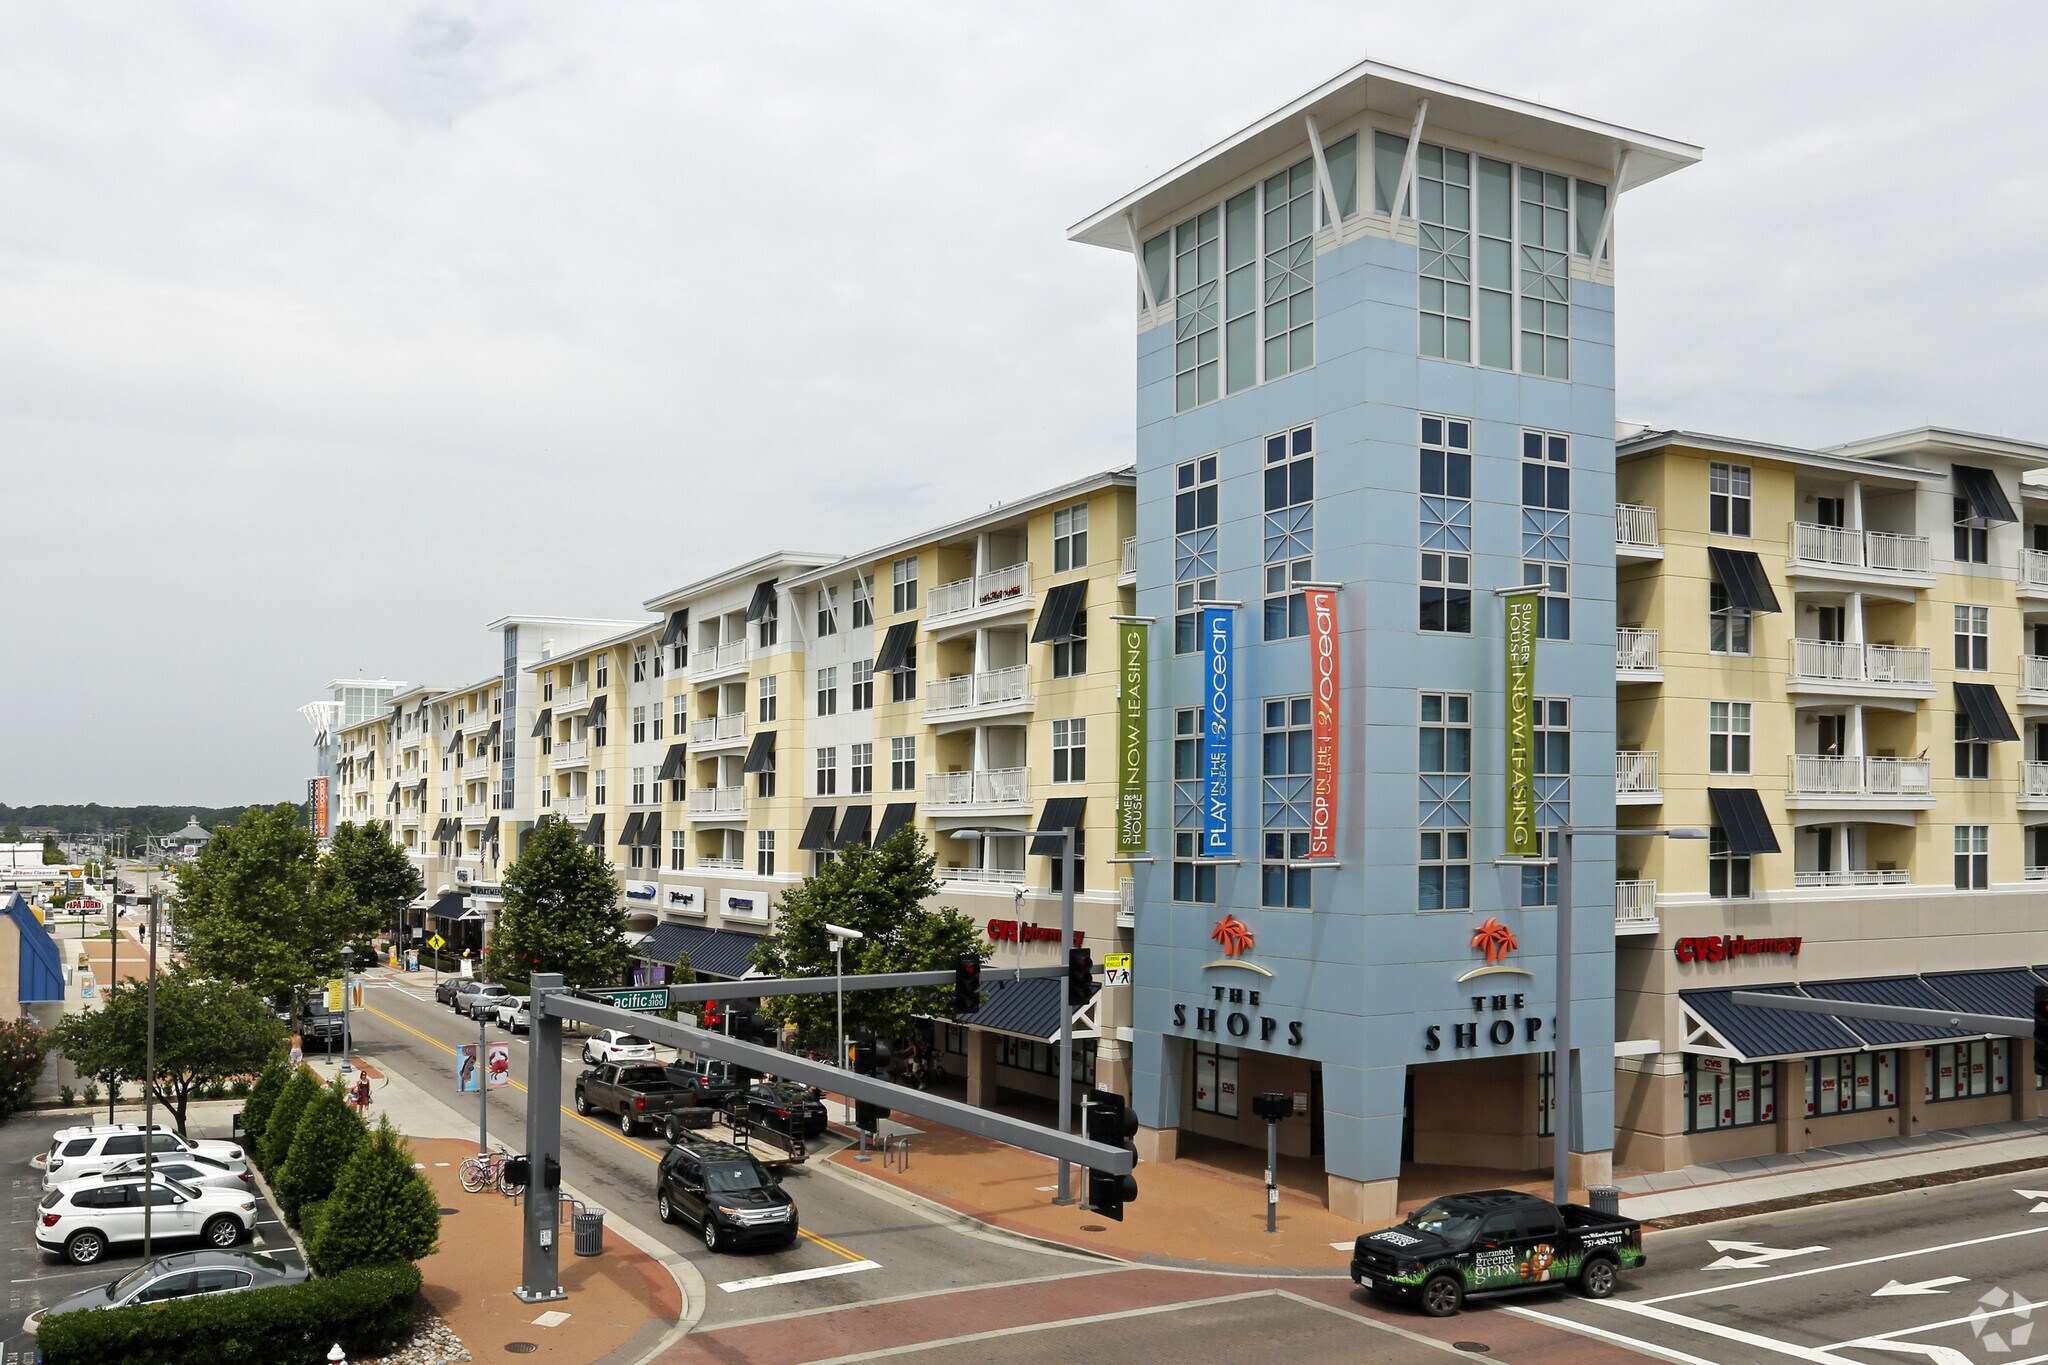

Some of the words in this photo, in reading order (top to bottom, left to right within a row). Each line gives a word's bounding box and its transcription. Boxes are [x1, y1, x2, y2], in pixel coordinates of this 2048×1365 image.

[1510, 604, 1521, 661] HOUSE
[1521, 603, 1532, 663] SUMMER
[1127, 631, 1141, 718] LEASING
[1512, 672, 1526, 740] NOW
[1127, 724, 1141, 784] NOW
[1211, 752, 1220, 777] THE
[1219, 752, 1227, 796] OCEAN
[1211, 781, 1219, 796] IN
[1316, 778, 1326, 795] IN
[1512, 747, 1529, 846] LEASING
[1122, 794, 1133, 844] SUMMER
[1132, 793, 1142, 845] HOUSE
[1210, 797, 1227, 847] PLAY
[1312, 796, 1330, 853] SHOP
[66, 900, 81, 909] PAPA
[648, 999, 664, 1007] 3100
[1211, 985, 1260, 1006] THE
[1472, 993, 1525, 1011] THE
[1173, 1003, 1303, 1046] SHOPS
[1425, 1016, 1556, 1051] SHOP
[1704, 1058, 1722, 1068] CVS
[1222, 1082, 1235, 1091] CVS
[1822, 1079, 1835, 1088] CVS
[1857, 1076, 1870, 1084] CVS
[1698, 1093, 1713, 1103] CVS
[1737, 1089, 1750, 1098] CVS
[1475, 1246, 1515, 1259] guaranteed
[1475, 1254, 1516, 1268] greener
[1475, 1262, 1516, 1285] grass
